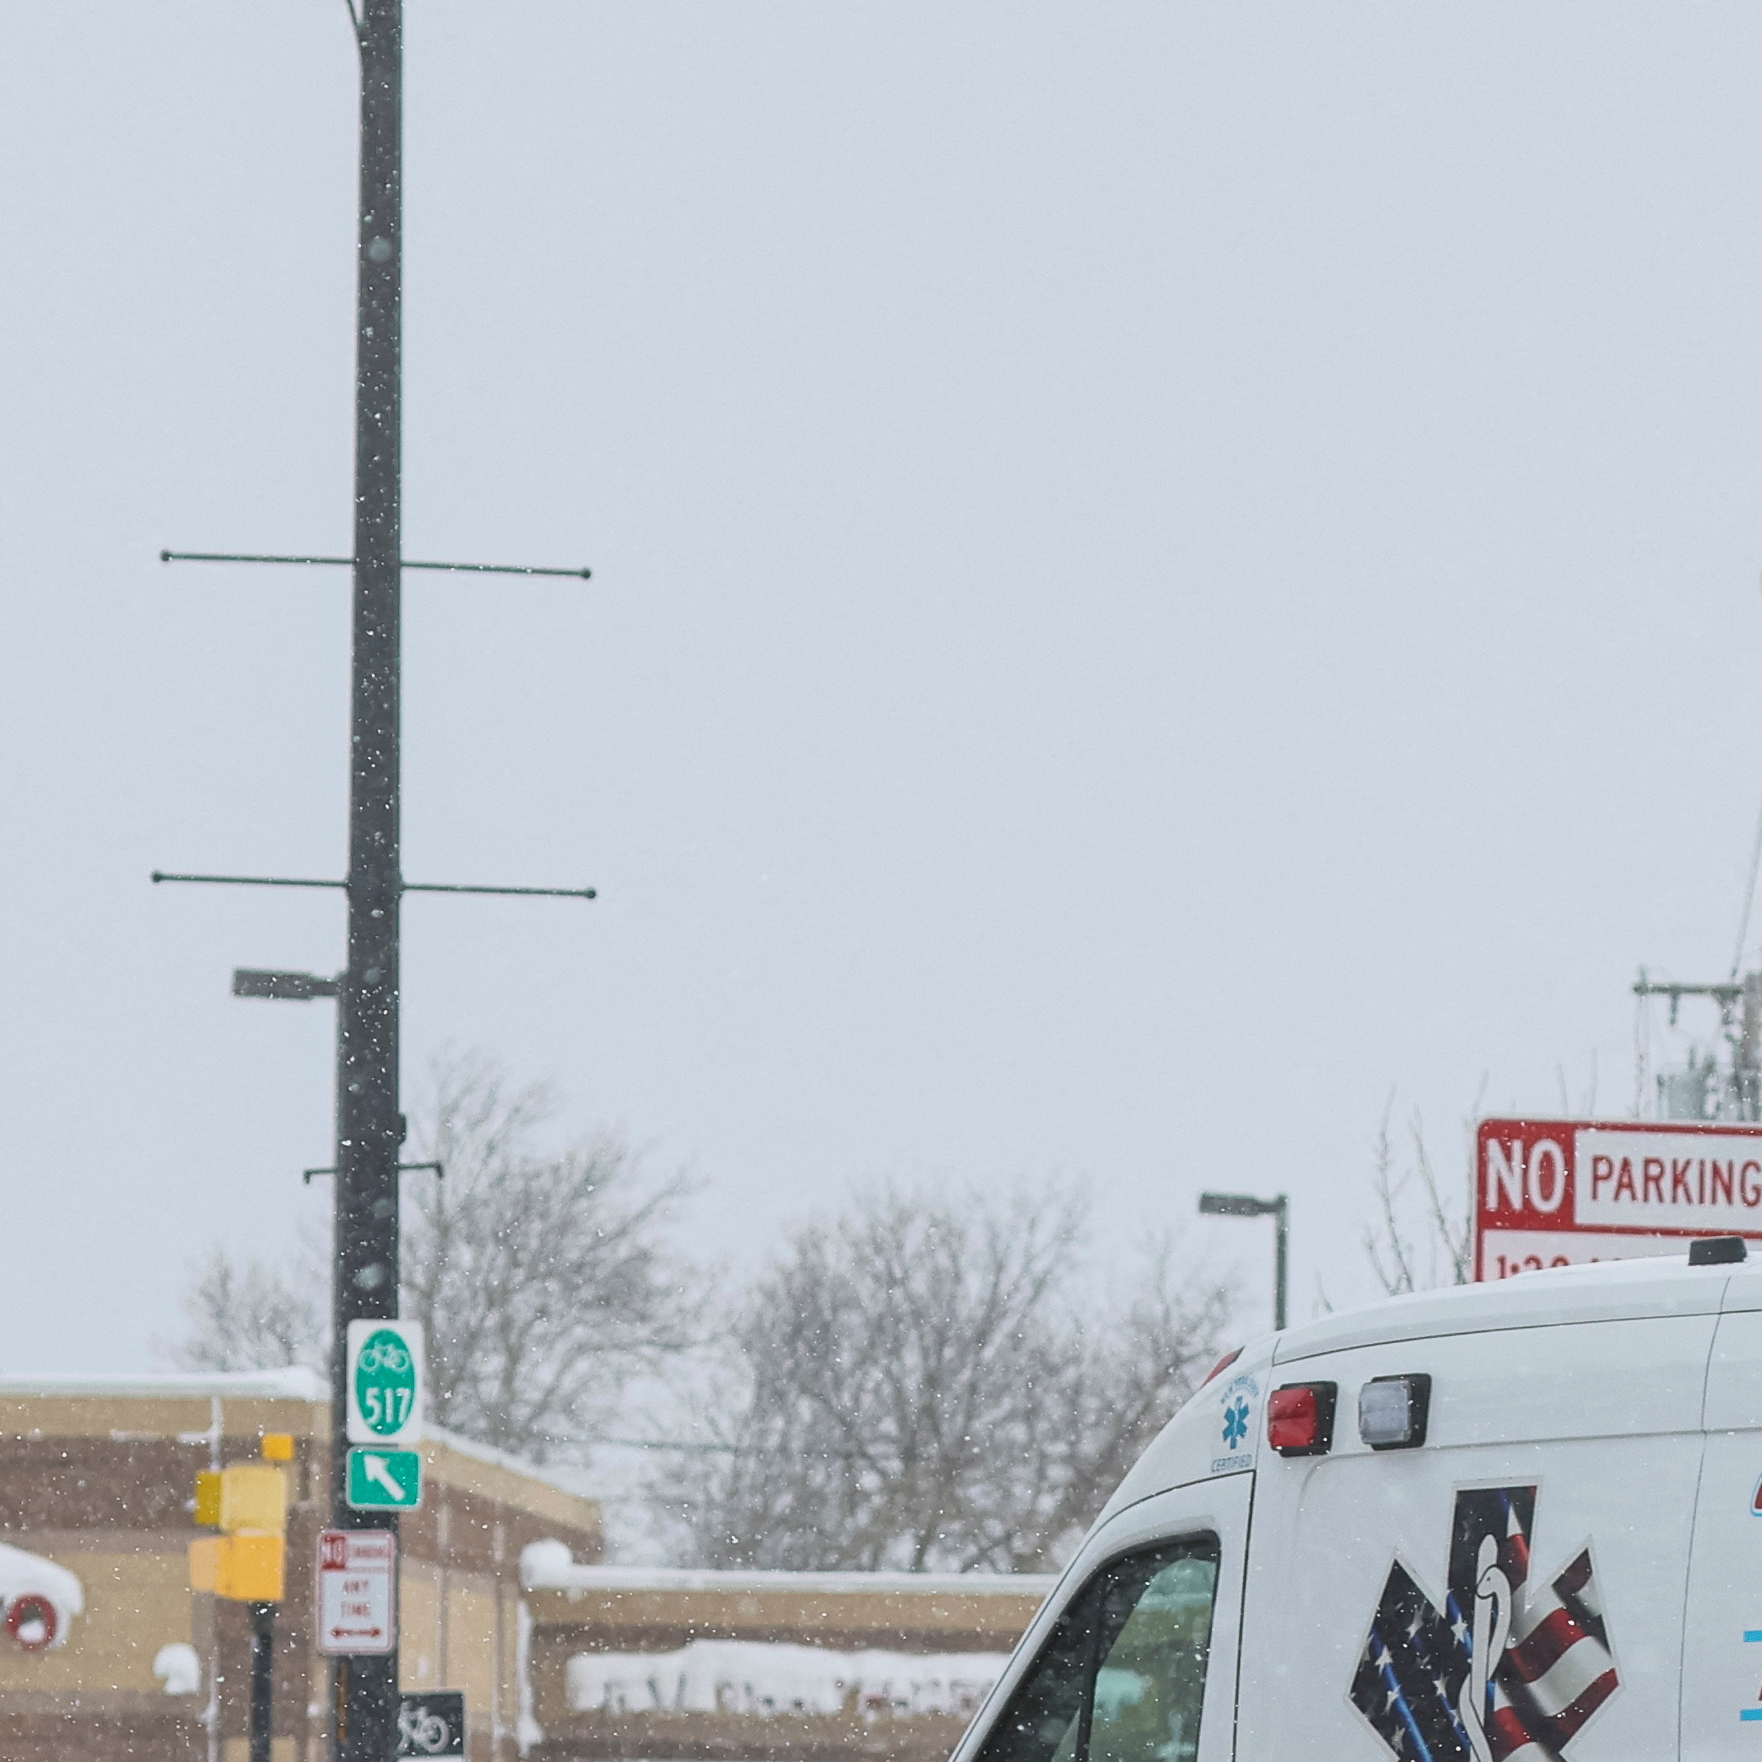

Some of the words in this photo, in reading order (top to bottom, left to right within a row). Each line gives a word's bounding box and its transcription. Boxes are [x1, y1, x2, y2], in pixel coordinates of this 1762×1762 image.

[1486, 1137, 1567, 1214] NO
[1591, 1155, 1762, 1208] PARKING
[365, 1387, 412, 1426] 517
